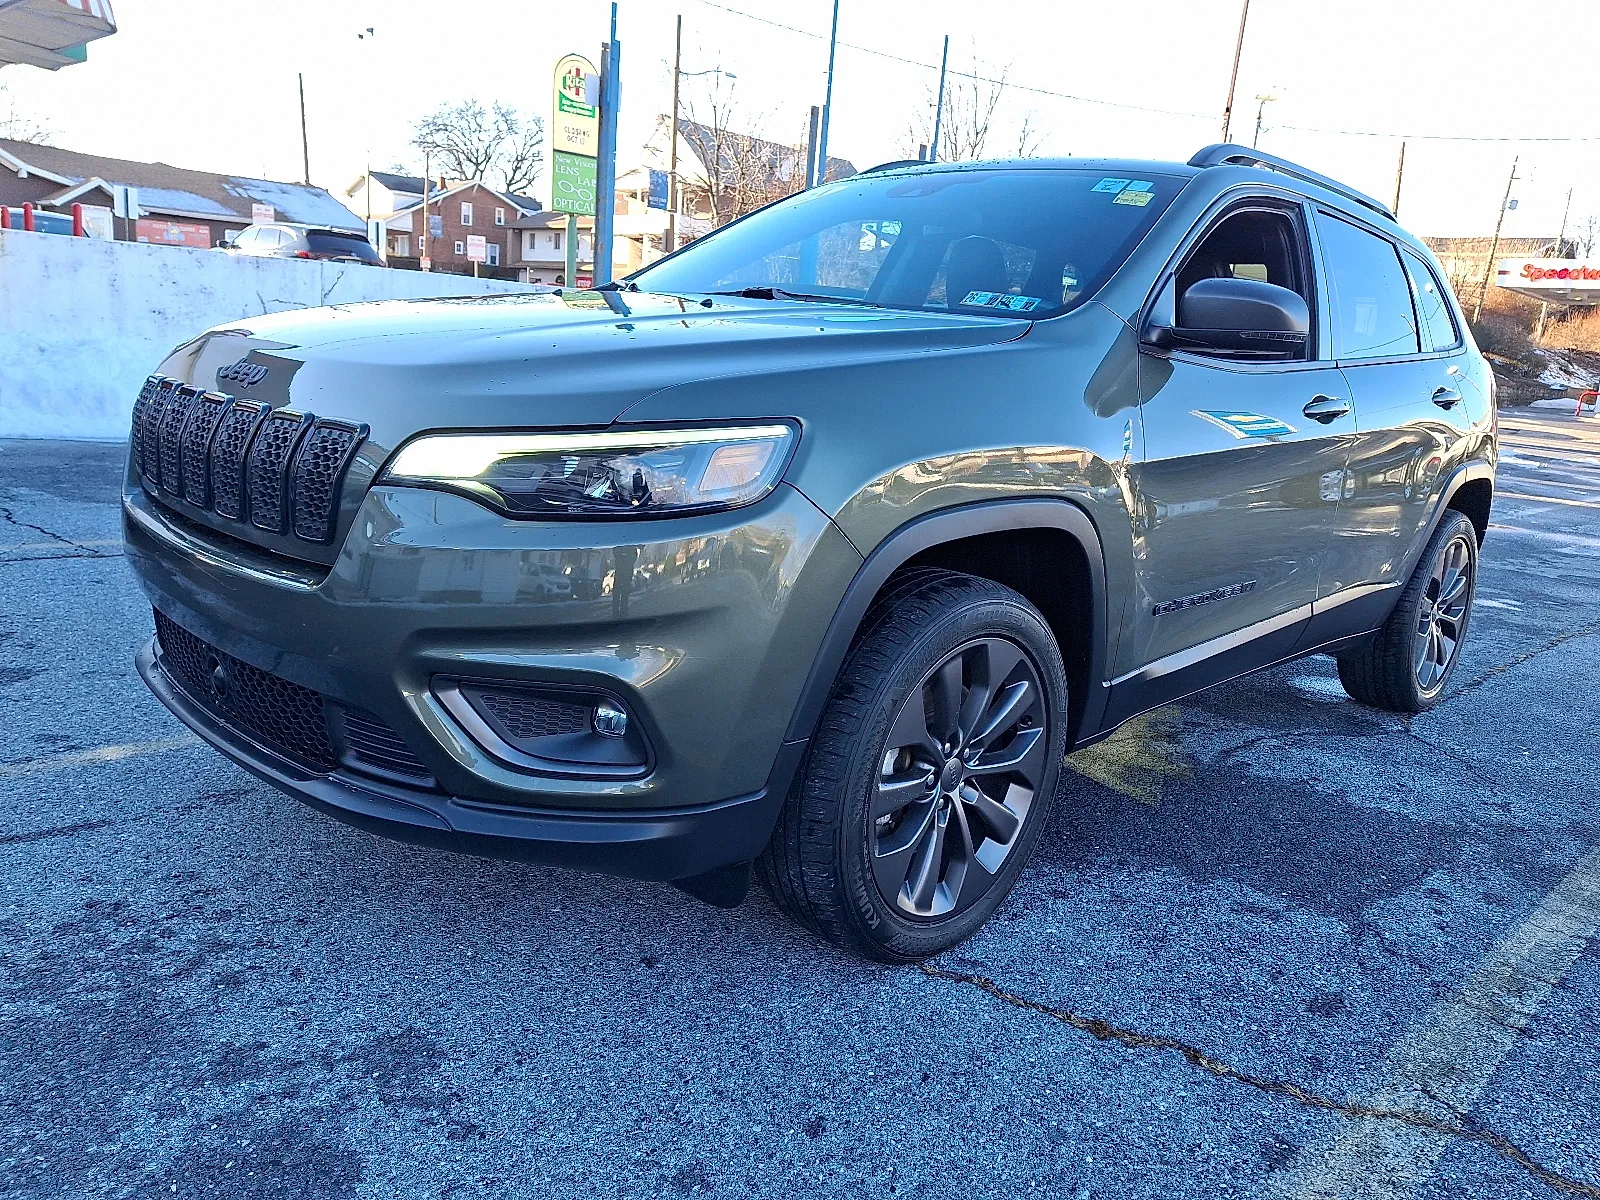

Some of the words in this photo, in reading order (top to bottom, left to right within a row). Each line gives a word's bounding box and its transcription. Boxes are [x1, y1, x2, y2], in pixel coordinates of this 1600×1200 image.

[564, 75, 586, 90] Rita
[563, 126, 590, 137] CLOSING
[555, 154, 571, 163] New
[574, 158, 597, 169] Vision
[555, 164, 580, 176] LENS
[577, 176, 597, 187] LAB
[554, 198, 596, 213] OPTICAL
[964, 292, 978, 302] 26
[219, 357, 269, 389] Jeep
[852, 854, 881, 930] KUMHO
